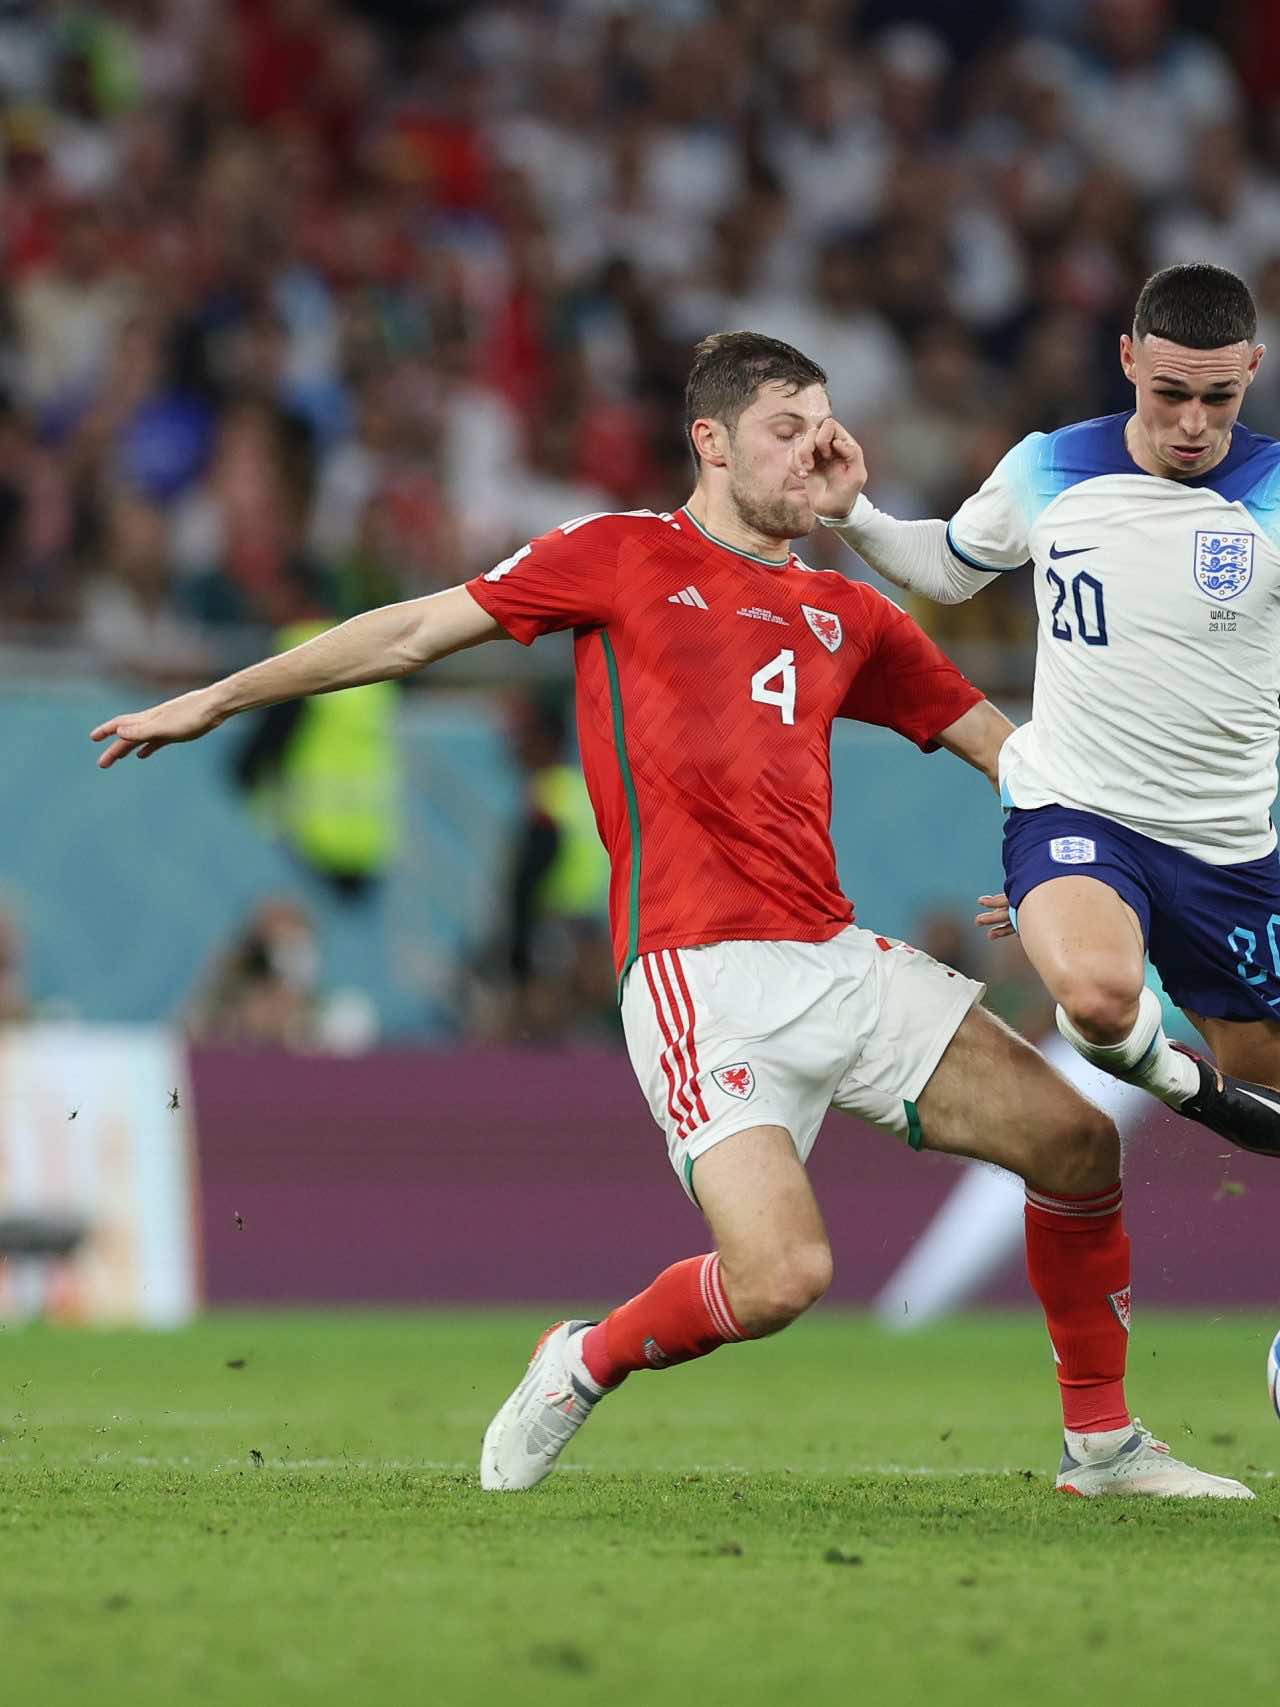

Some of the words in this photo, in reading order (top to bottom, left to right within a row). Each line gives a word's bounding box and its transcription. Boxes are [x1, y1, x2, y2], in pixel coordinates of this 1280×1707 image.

[1046, 567, 1108, 646] 20
[1210, 610, 1236, 620] WALES
[751, 648, 797, 725] 4
